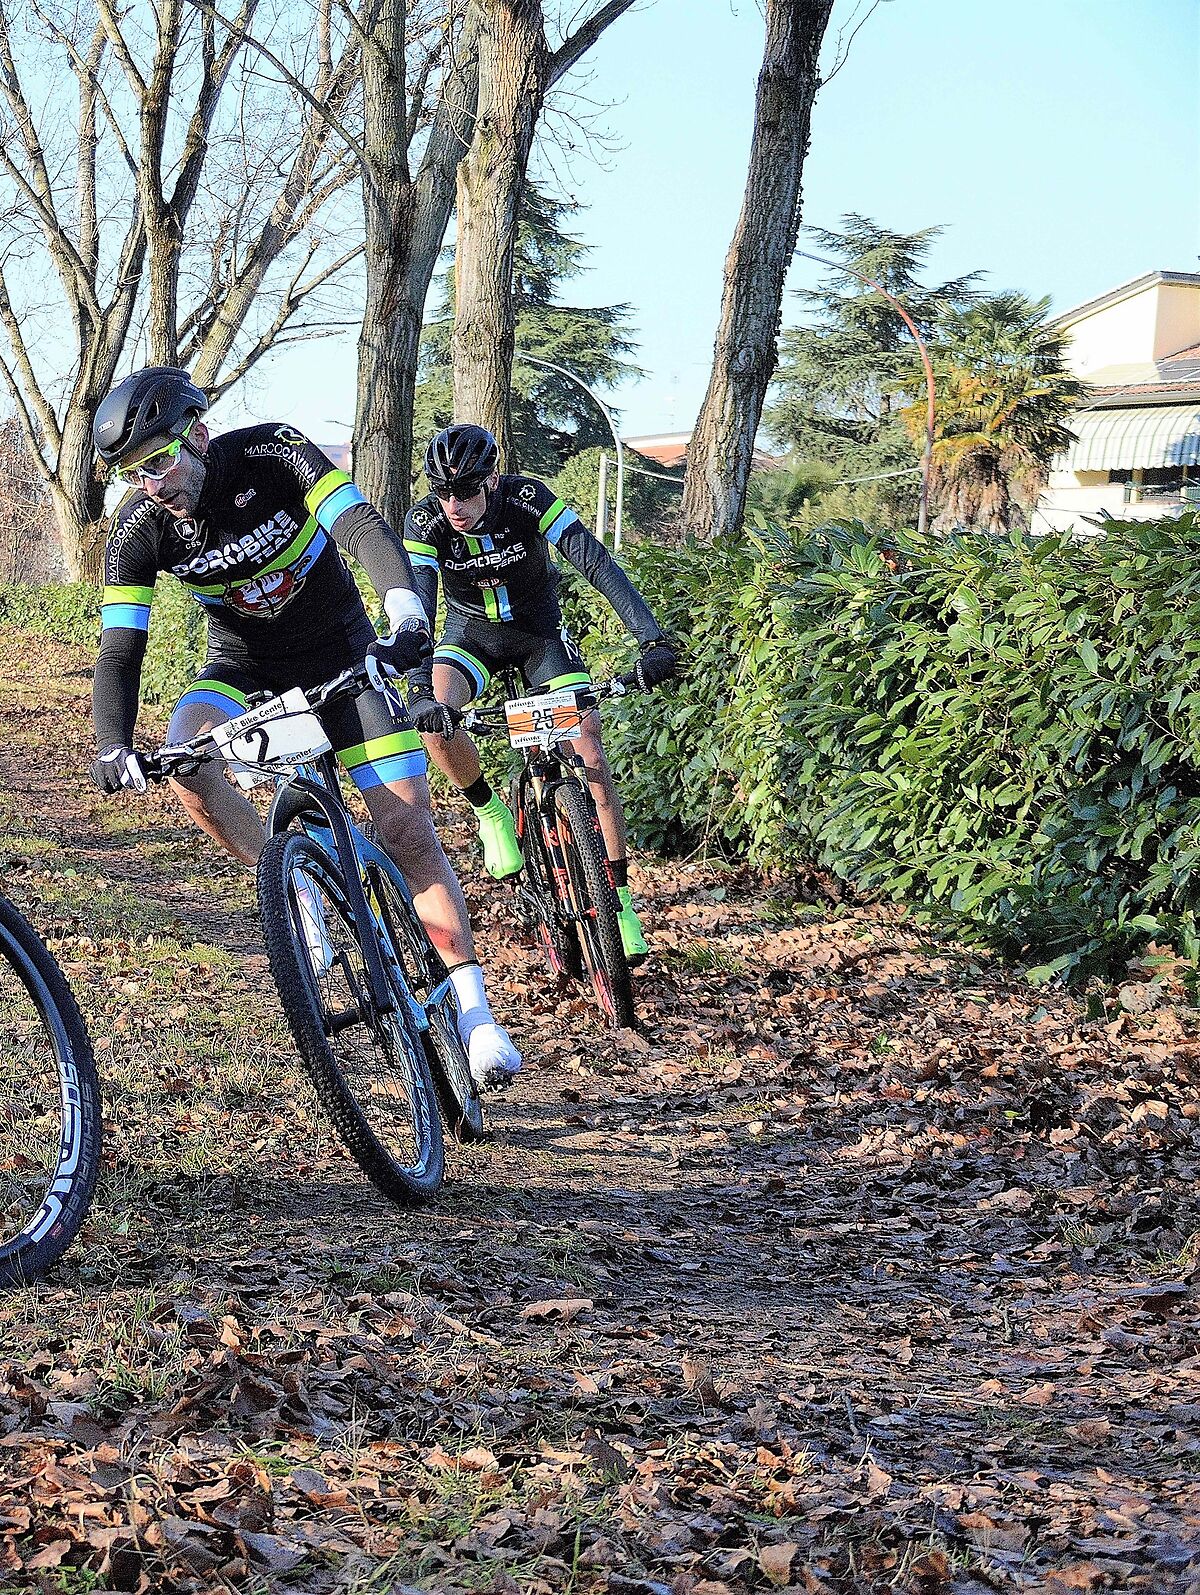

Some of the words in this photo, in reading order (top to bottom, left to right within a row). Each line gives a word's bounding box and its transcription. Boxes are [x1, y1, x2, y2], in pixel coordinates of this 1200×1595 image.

[493, 551, 527, 571] TEAM
[240, 716, 258, 727] Bike
[260, 702, 287, 718] Cente
[531, 708, 554, 731] 25
[244, 727, 281, 767] 2
[286, 747, 312, 764] Center
